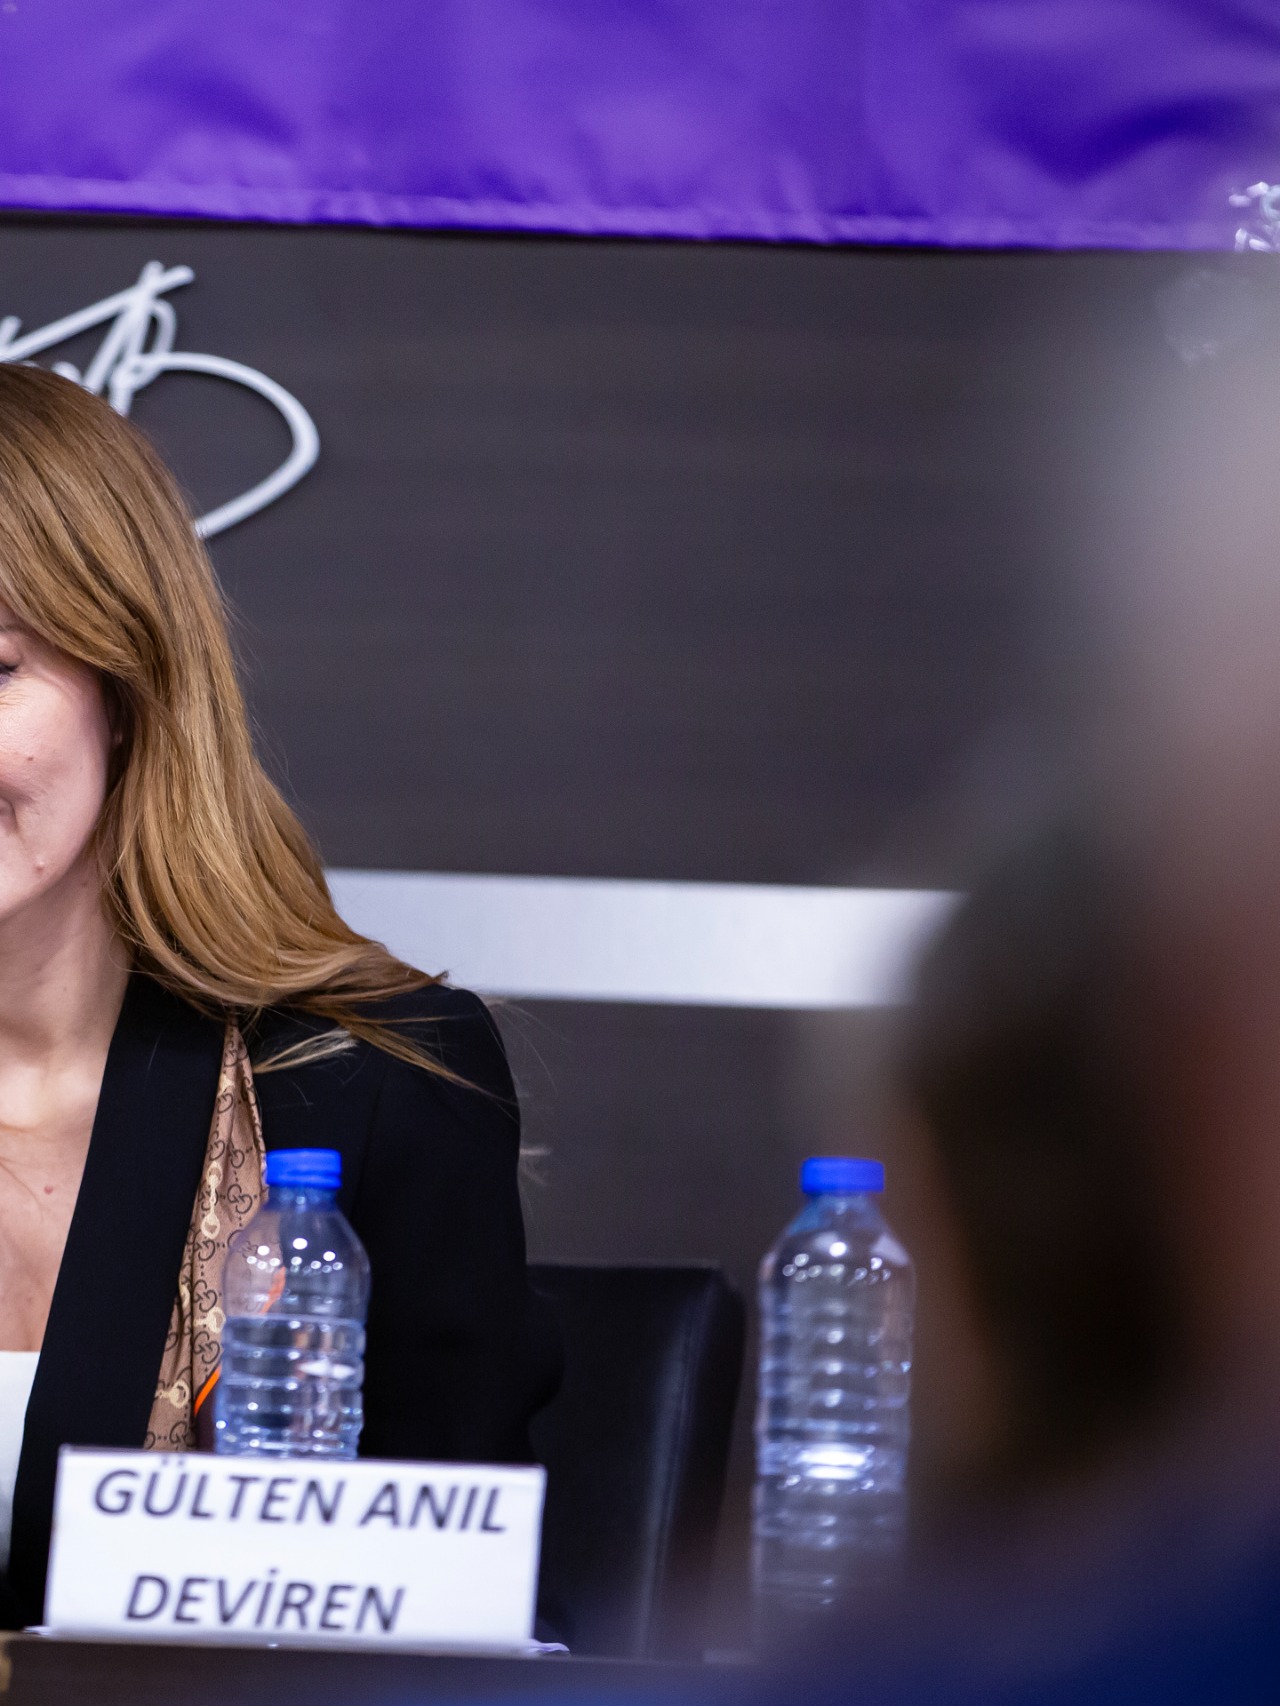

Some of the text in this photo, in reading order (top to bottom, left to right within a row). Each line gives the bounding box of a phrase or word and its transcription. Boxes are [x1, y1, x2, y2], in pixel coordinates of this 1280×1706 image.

[95, 1460, 506, 1532] GÜLTEN ANIL
[126, 1569, 405, 1633] DEVİREN
